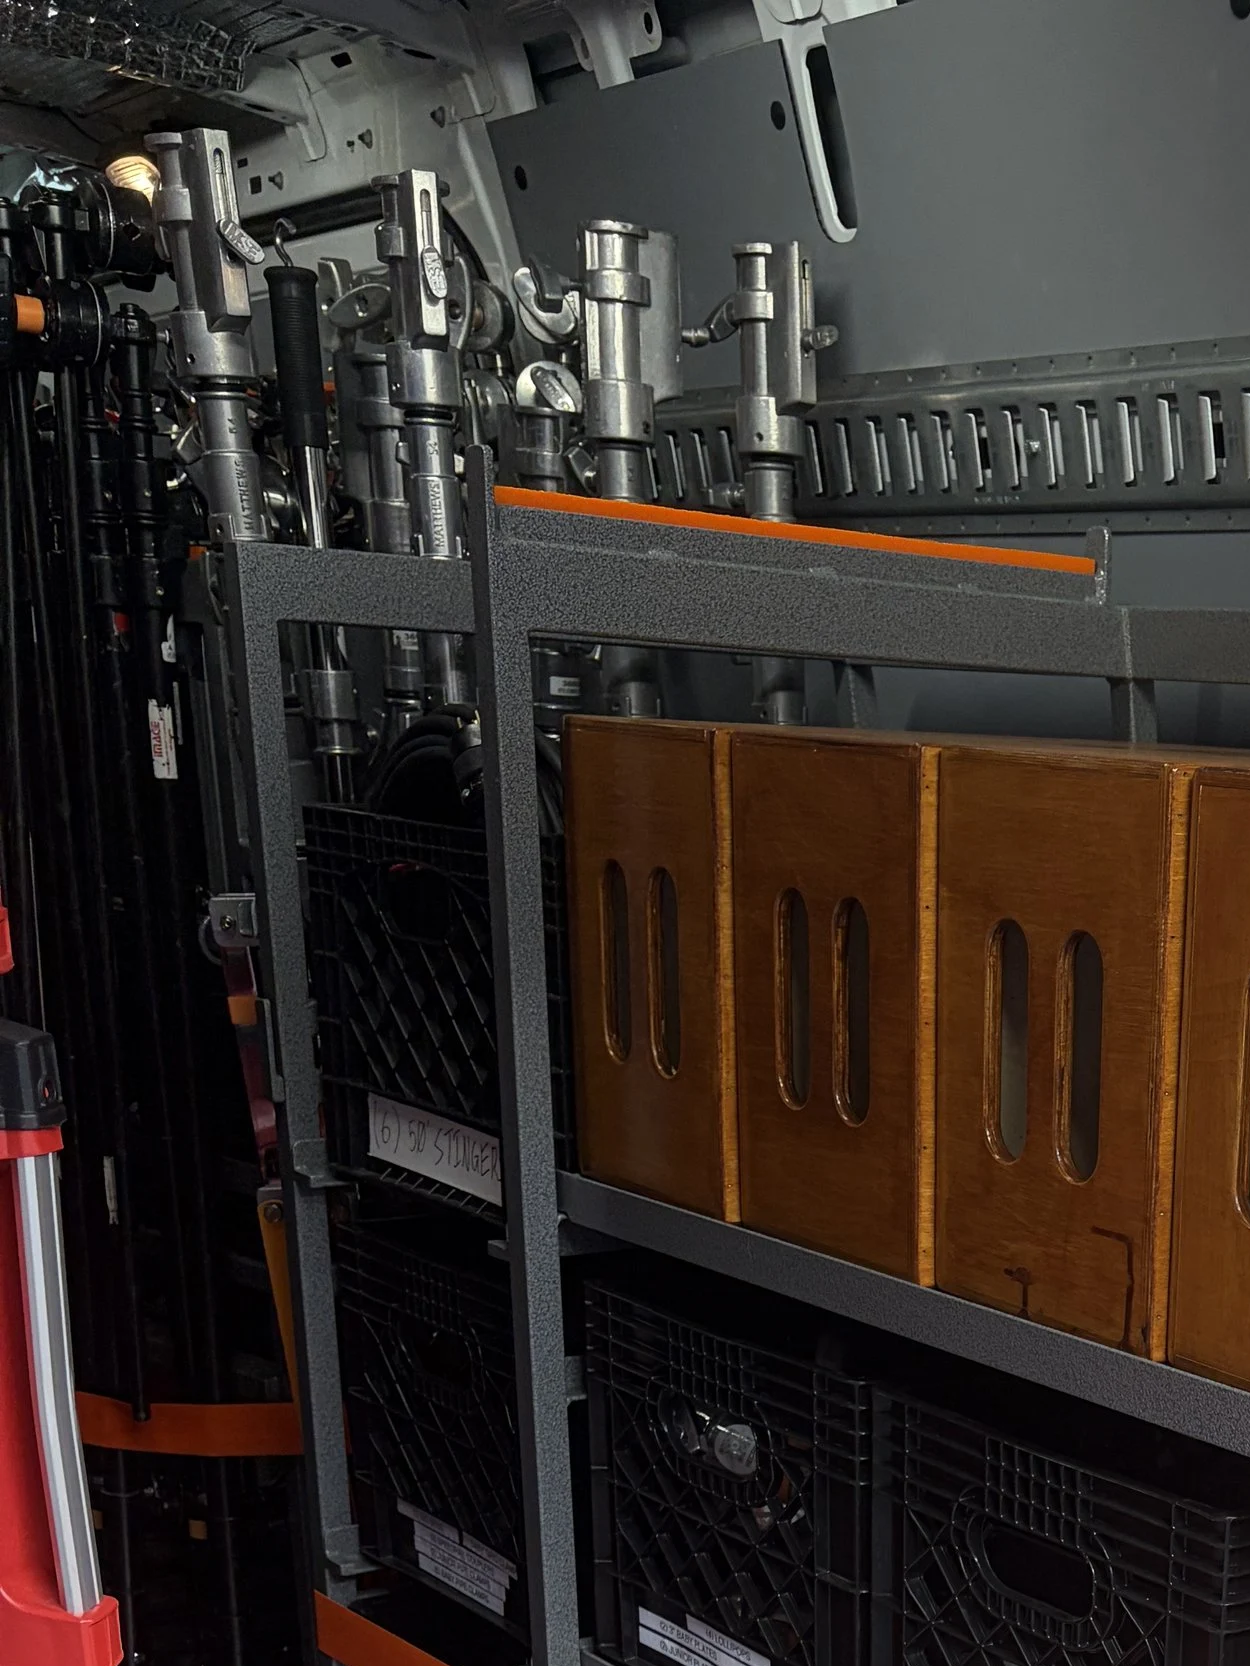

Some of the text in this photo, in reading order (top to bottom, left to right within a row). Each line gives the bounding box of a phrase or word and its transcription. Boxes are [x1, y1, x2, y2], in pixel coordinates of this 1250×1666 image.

[234, 460, 254, 530] MATTHEWS
[429, 480, 446, 548] MATTHEWS
[373, 1100, 400, 1154] (6)
[669, 1646, 693, 1666] JUNIOR
[694, 1639, 718, 1661] PLATES
